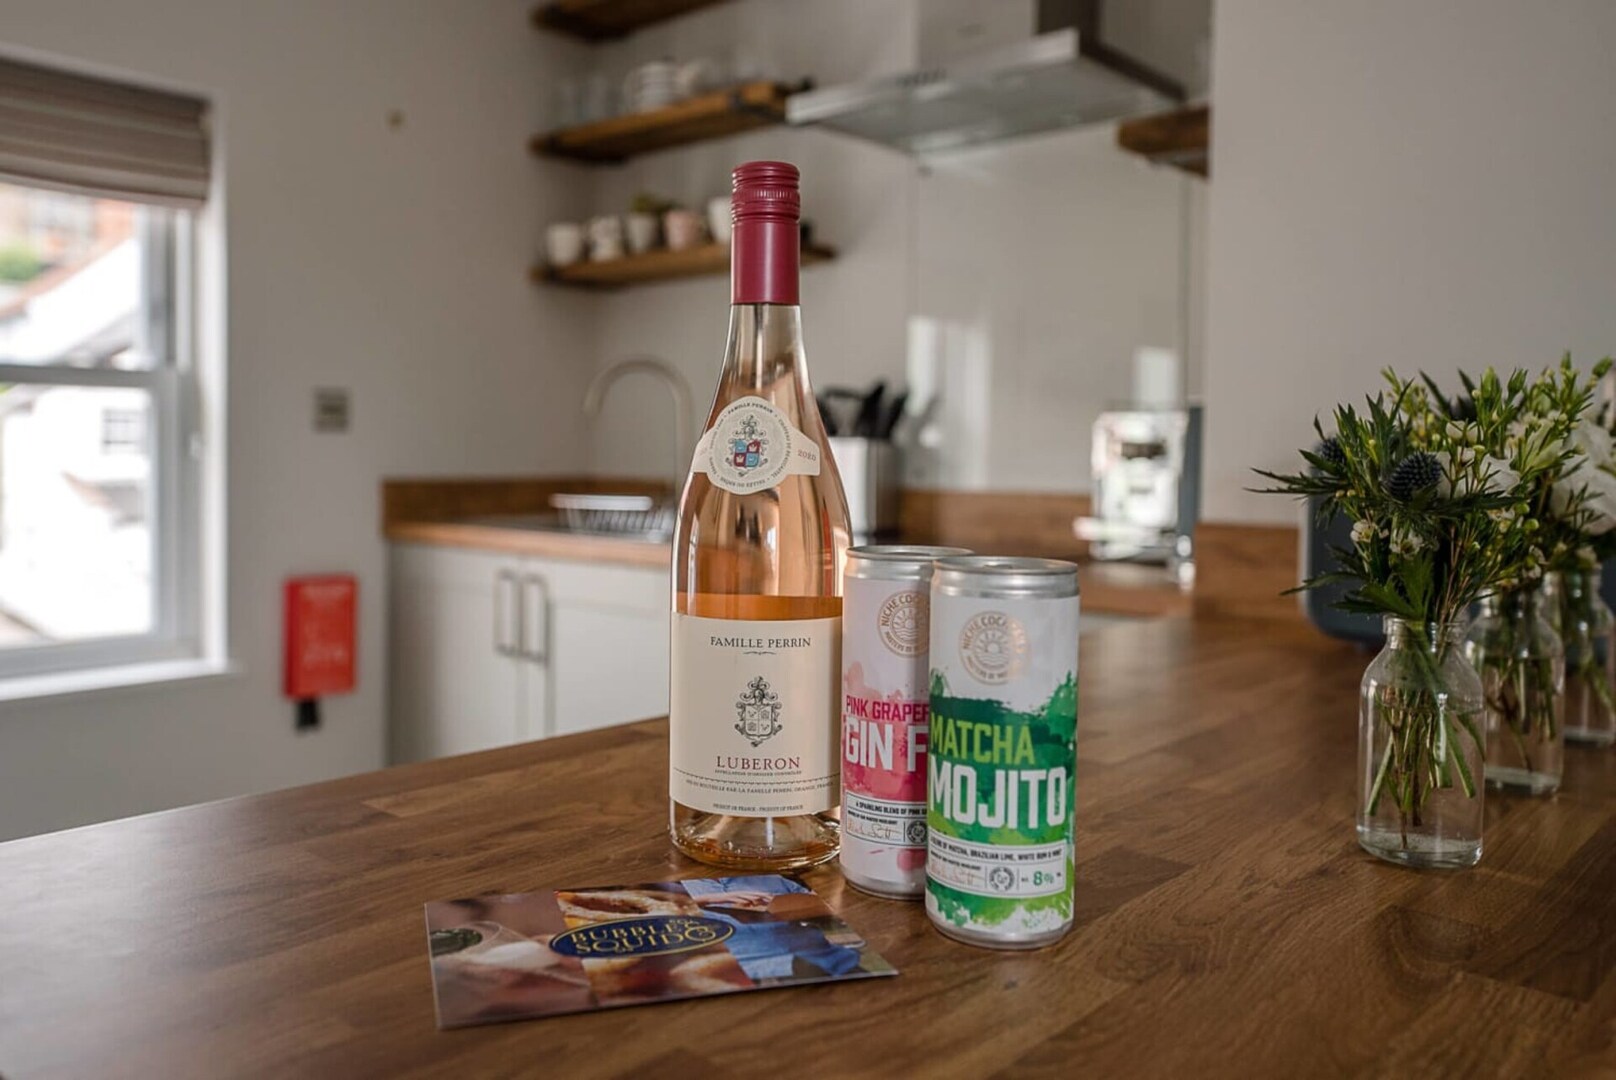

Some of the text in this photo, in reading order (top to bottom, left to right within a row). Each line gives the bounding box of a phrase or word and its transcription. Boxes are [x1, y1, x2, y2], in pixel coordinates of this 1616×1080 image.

[797, 449, 817, 462] 2020
[710, 636, 811, 648] FAMILLE PERRIN
[846, 694, 869, 718] PINK
[845, 715, 894, 772] GIN
[930, 711, 1036, 766] MATCHA
[716, 755, 801, 770] LUBERON
[929, 753, 1067, 829] MOJITO
